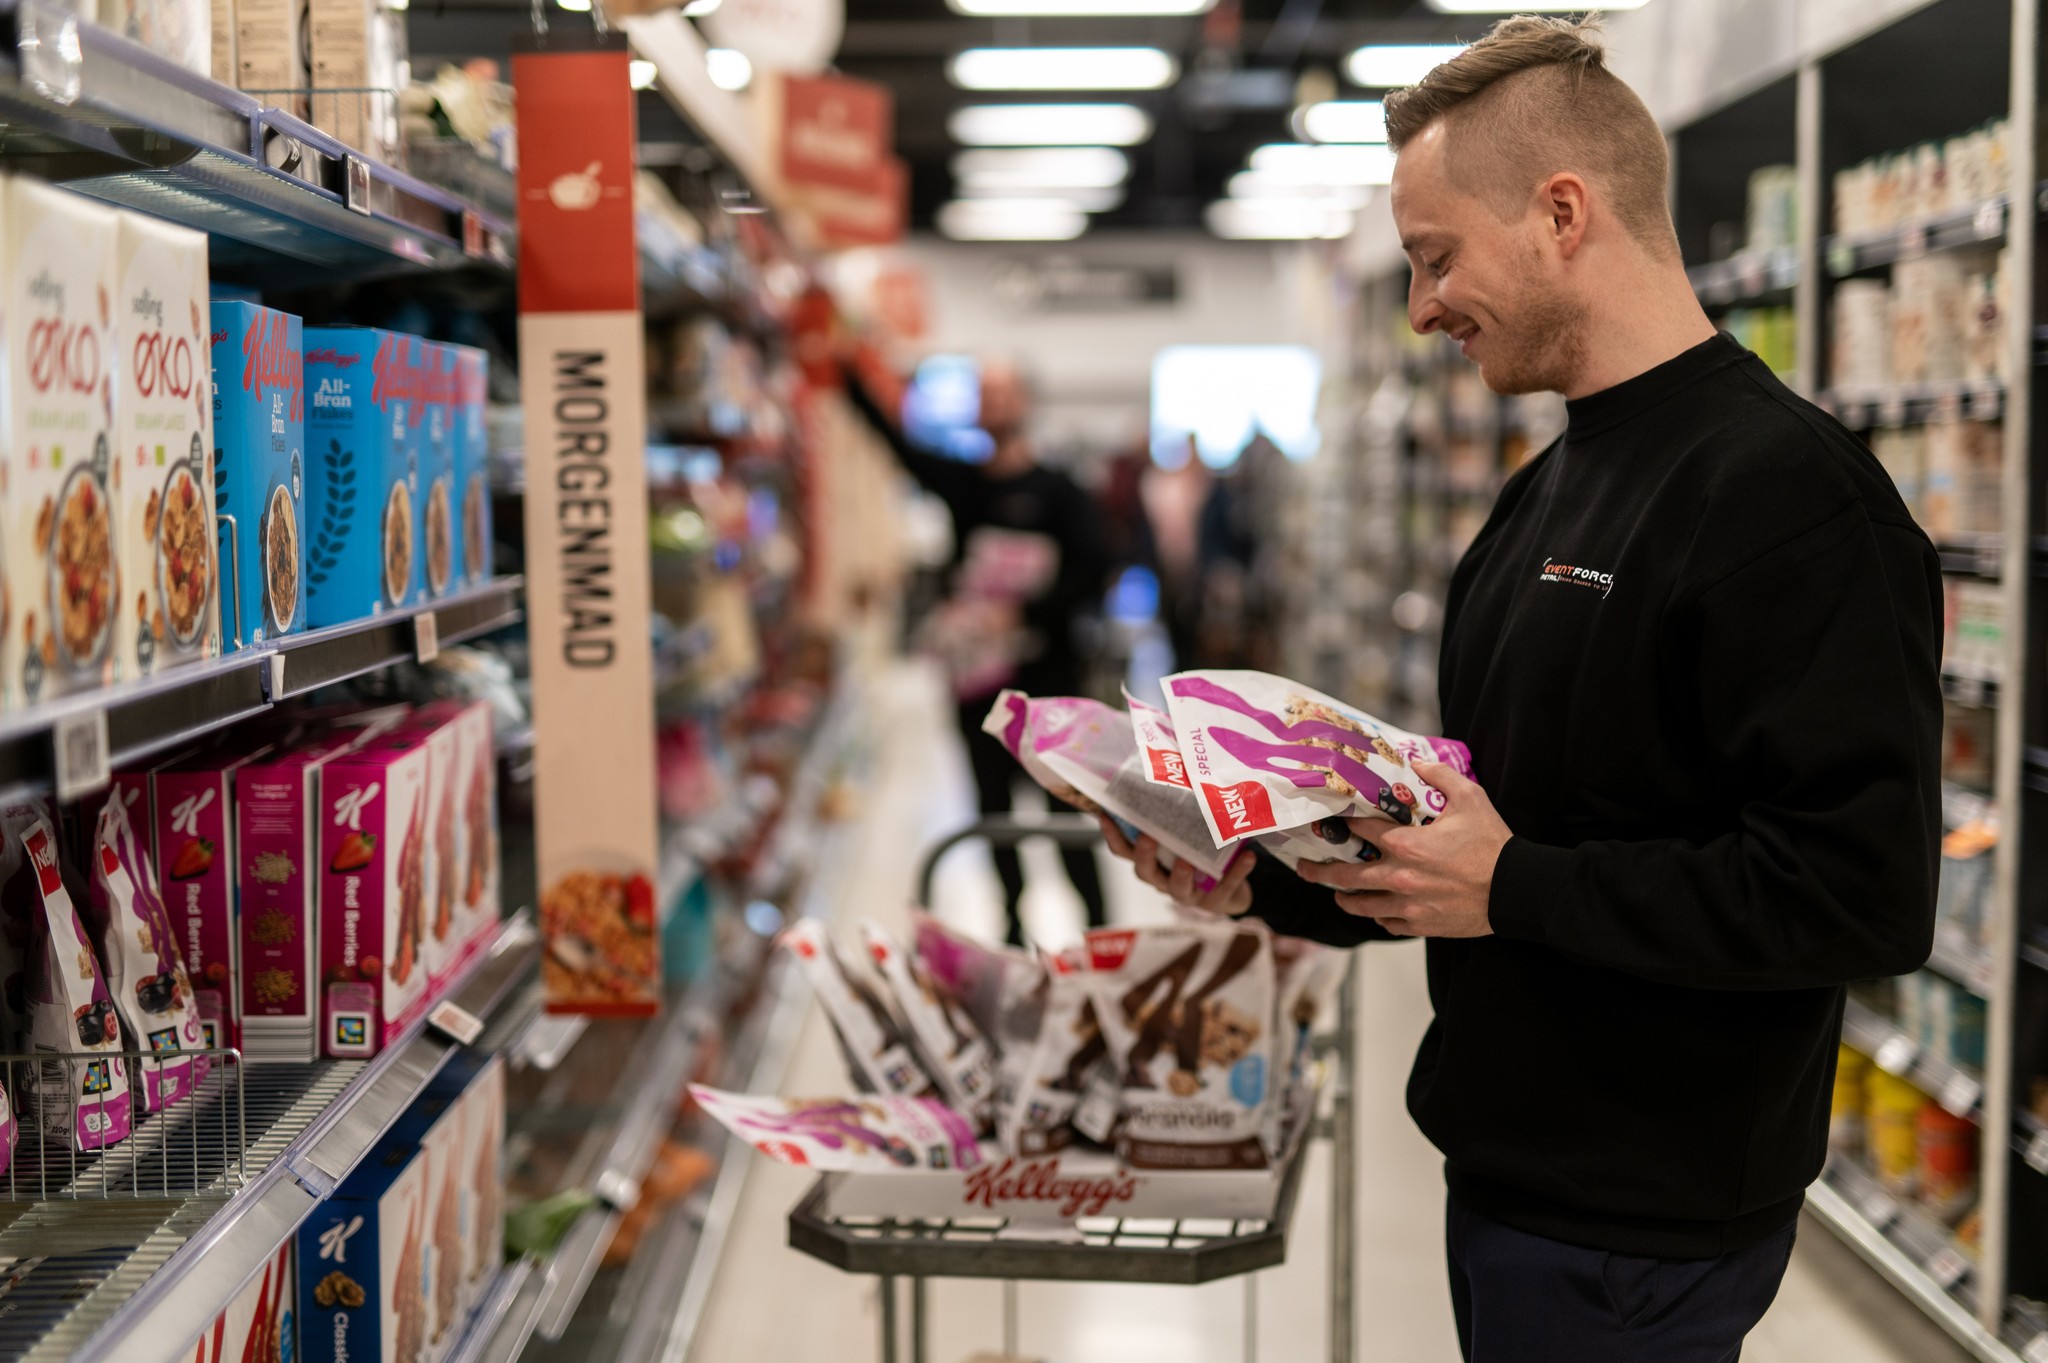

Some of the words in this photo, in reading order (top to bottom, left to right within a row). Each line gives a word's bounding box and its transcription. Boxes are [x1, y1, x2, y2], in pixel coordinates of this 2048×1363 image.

[27, 317, 100, 396] ØKO
[133, 331, 193, 400] ØKO
[314, 392, 352, 408] Bran
[319, 377, 351, 394] All-
[555, 352, 616, 669] MORGENMAD
[1162, 752, 1185, 785] NEW
[1190, 727, 1212, 776] SPECIAL
[1218, 788, 1252, 830] NEW
[186, 883, 202, 915] Red
[345, 876, 361, 908] Red
[188, 917, 203, 974] Berries
[344, 910, 360, 967] Berries
[964, 1157, 1137, 1217] Kellogg's
